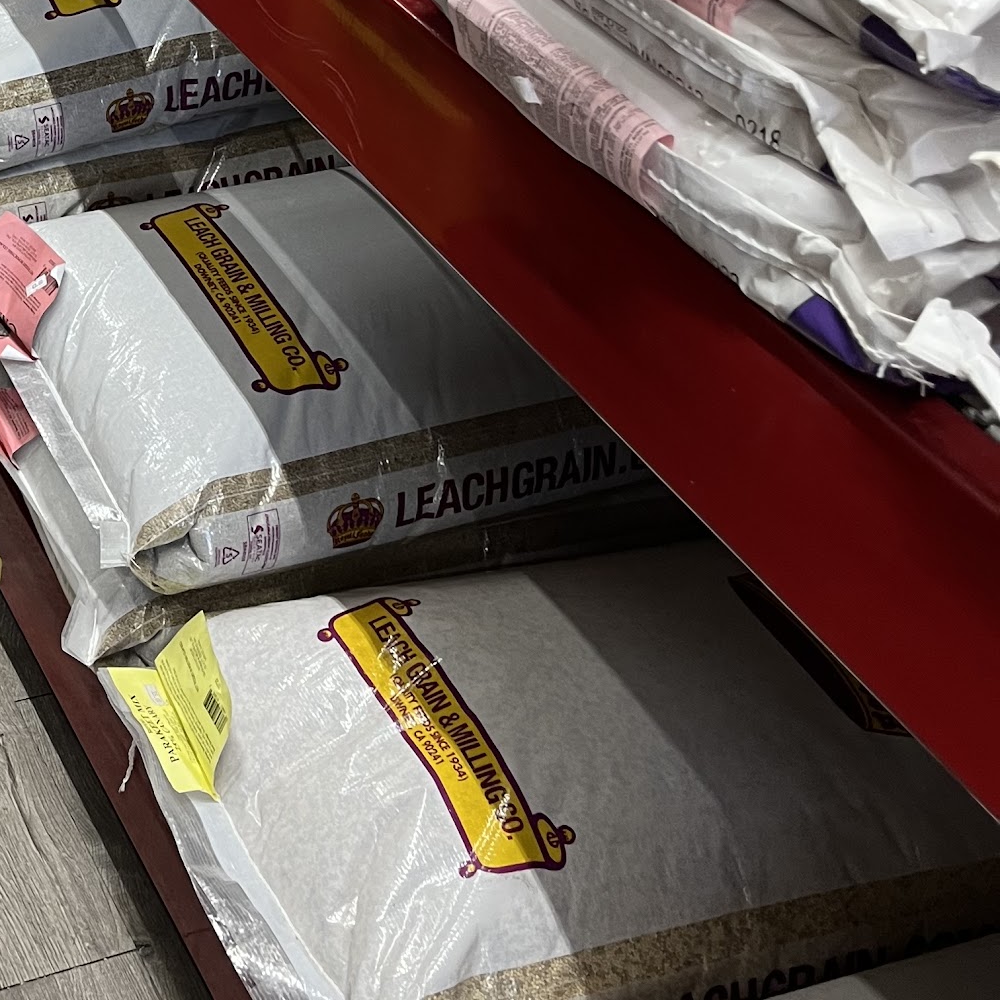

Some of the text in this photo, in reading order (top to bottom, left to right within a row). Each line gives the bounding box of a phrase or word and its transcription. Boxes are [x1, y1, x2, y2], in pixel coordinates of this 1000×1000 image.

[183, 217, 307, 371] LEACH GRAIN & MILLING CO.
[213, 292, 226, 305] CA
[222, 303, 242, 325] 90241
[215, 277, 233, 296] FEEDS
[229, 295, 248, 315] SINCE
[368, 615, 524, 841] LEACH GRAIN & MILLING CO.
[390, 673, 419, 704] (QLITY
[430, 730, 451, 752] SINCE
[446, 751, 469, 782] 1934)
[413, 730, 426, 744] CA
[421, 740, 445, 765] 90241
